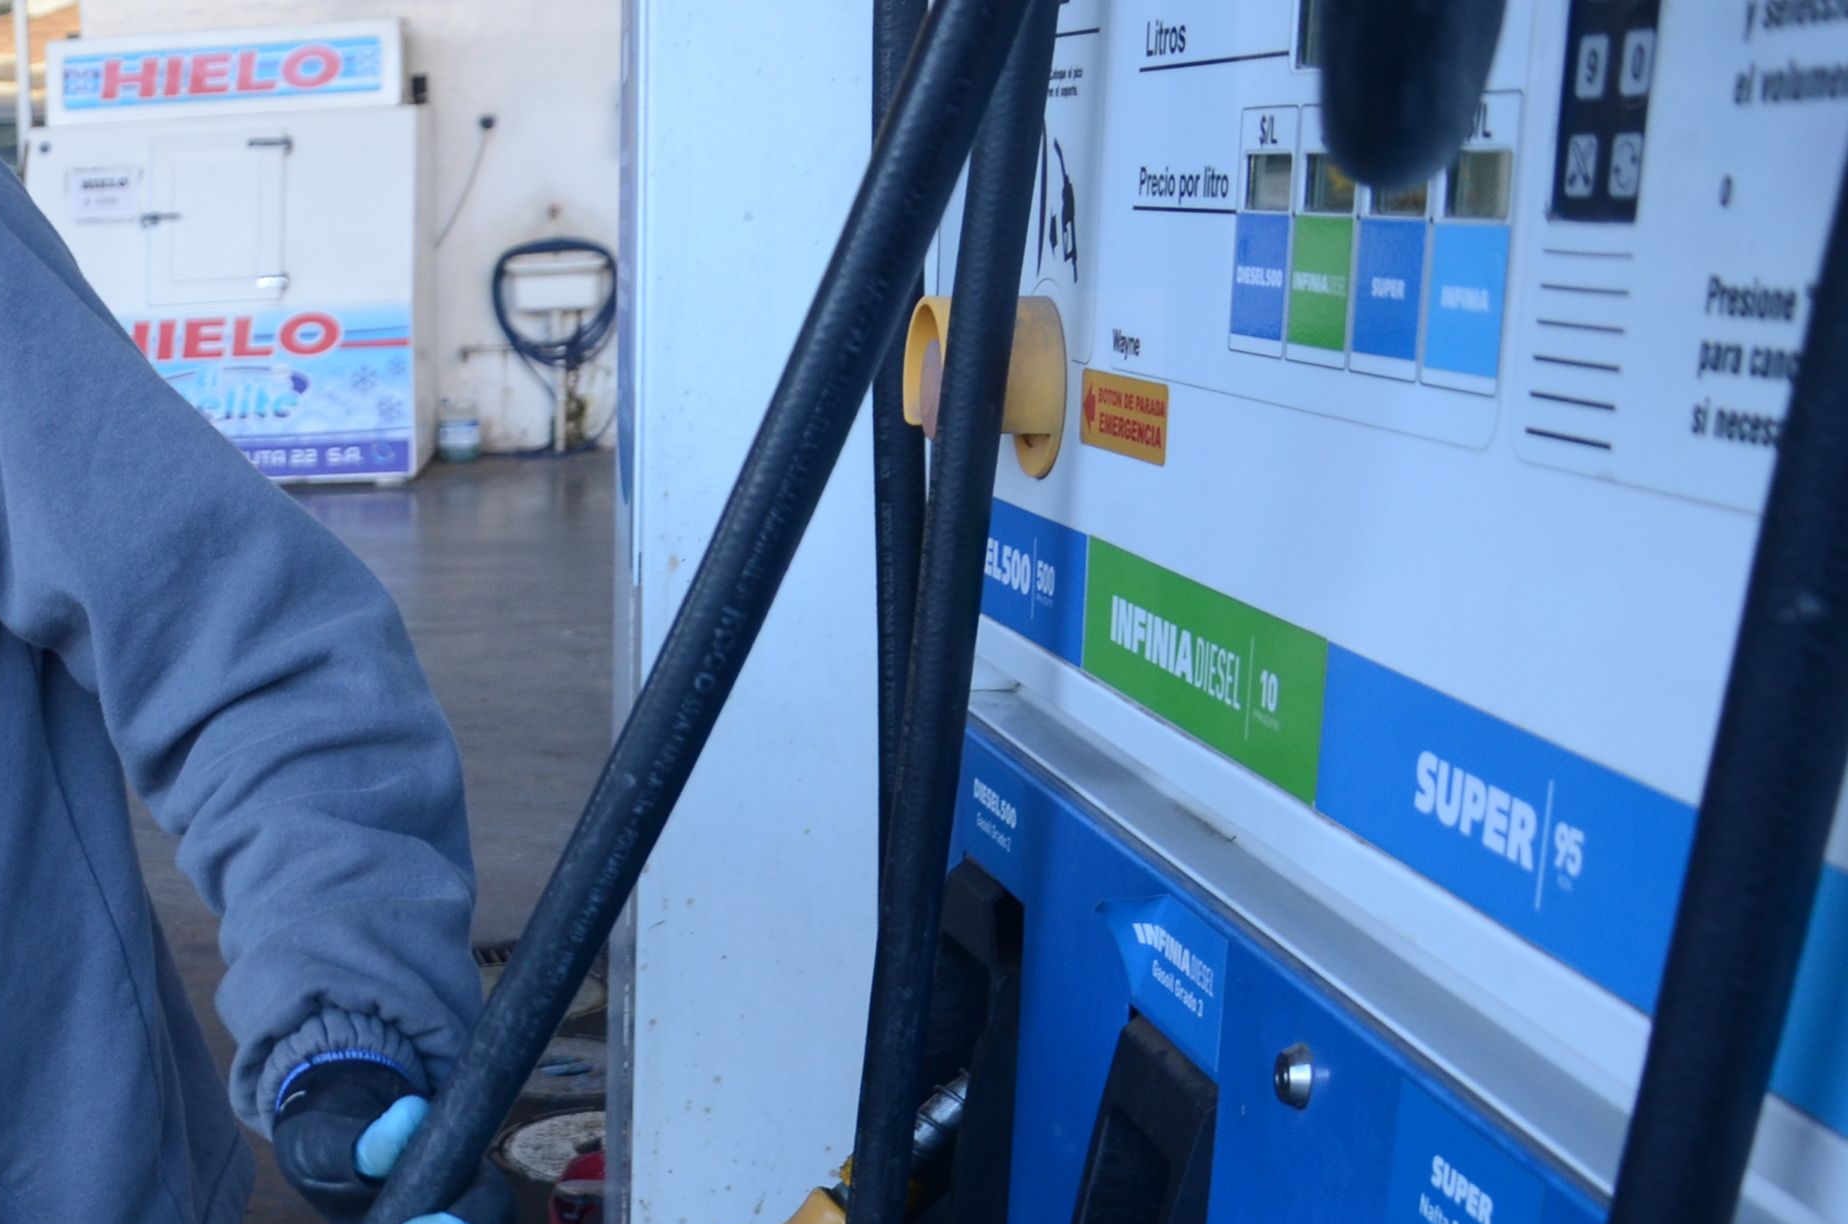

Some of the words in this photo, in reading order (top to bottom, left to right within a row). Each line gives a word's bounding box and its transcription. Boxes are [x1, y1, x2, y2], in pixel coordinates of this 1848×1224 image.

[1146, 20, 1186, 57] Litros
[101, 43, 343, 100] HIELO
[1586, 48, 1600, 84] 9
[1631, 43, 1646, 81] 0
[1139, 166, 1176, 197] Precio
[1178, 174, 1200, 205] por
[1203, 166, 1229, 198] litro
[1236, 265, 1283, 288] DIESEL500
[1371, 276, 1405, 300] SUPER
[1705, 273, 1797, 322] Presione
[1112, 327, 1140, 360] Wayne
[1697, 339, 1742, 378] para
[1124, 393, 1134, 411] DE
[1099, 412, 1162, 449] EMERGENCIA
[1691, 397, 1711, 437] si
[1713, 407, 1783, 448] neces
[290, 447, 319, 466] 22
[984, 537, 1031, 596] EL500
[1036, 560, 1055, 597] 500
[1260, 669, 1279, 713] 10
[974, 777, 1016, 829] DIESEL500
[1414, 750, 1538, 873] SUPER
[1554, 821, 1585, 878] 95
[1152, 959, 1174, 993] Gasoil
[1174, 978, 1197, 1012] Grado
[1197, 999, 1204, 1019] 3
